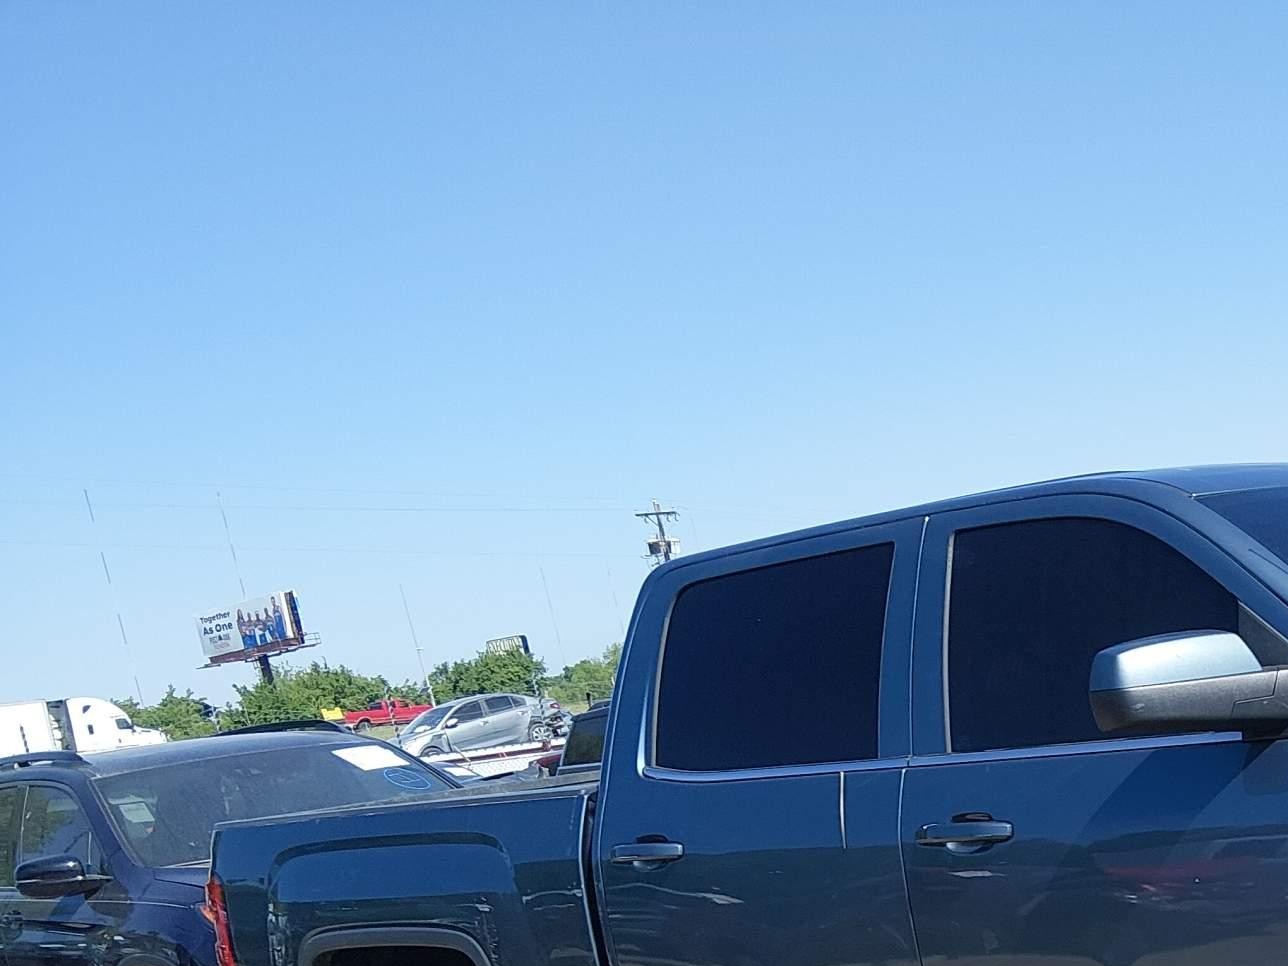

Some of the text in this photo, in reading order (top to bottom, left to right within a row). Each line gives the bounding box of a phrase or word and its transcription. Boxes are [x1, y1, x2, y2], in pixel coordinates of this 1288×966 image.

[200, 611, 231, 625] Together
[203, 621, 233, 636] As One
